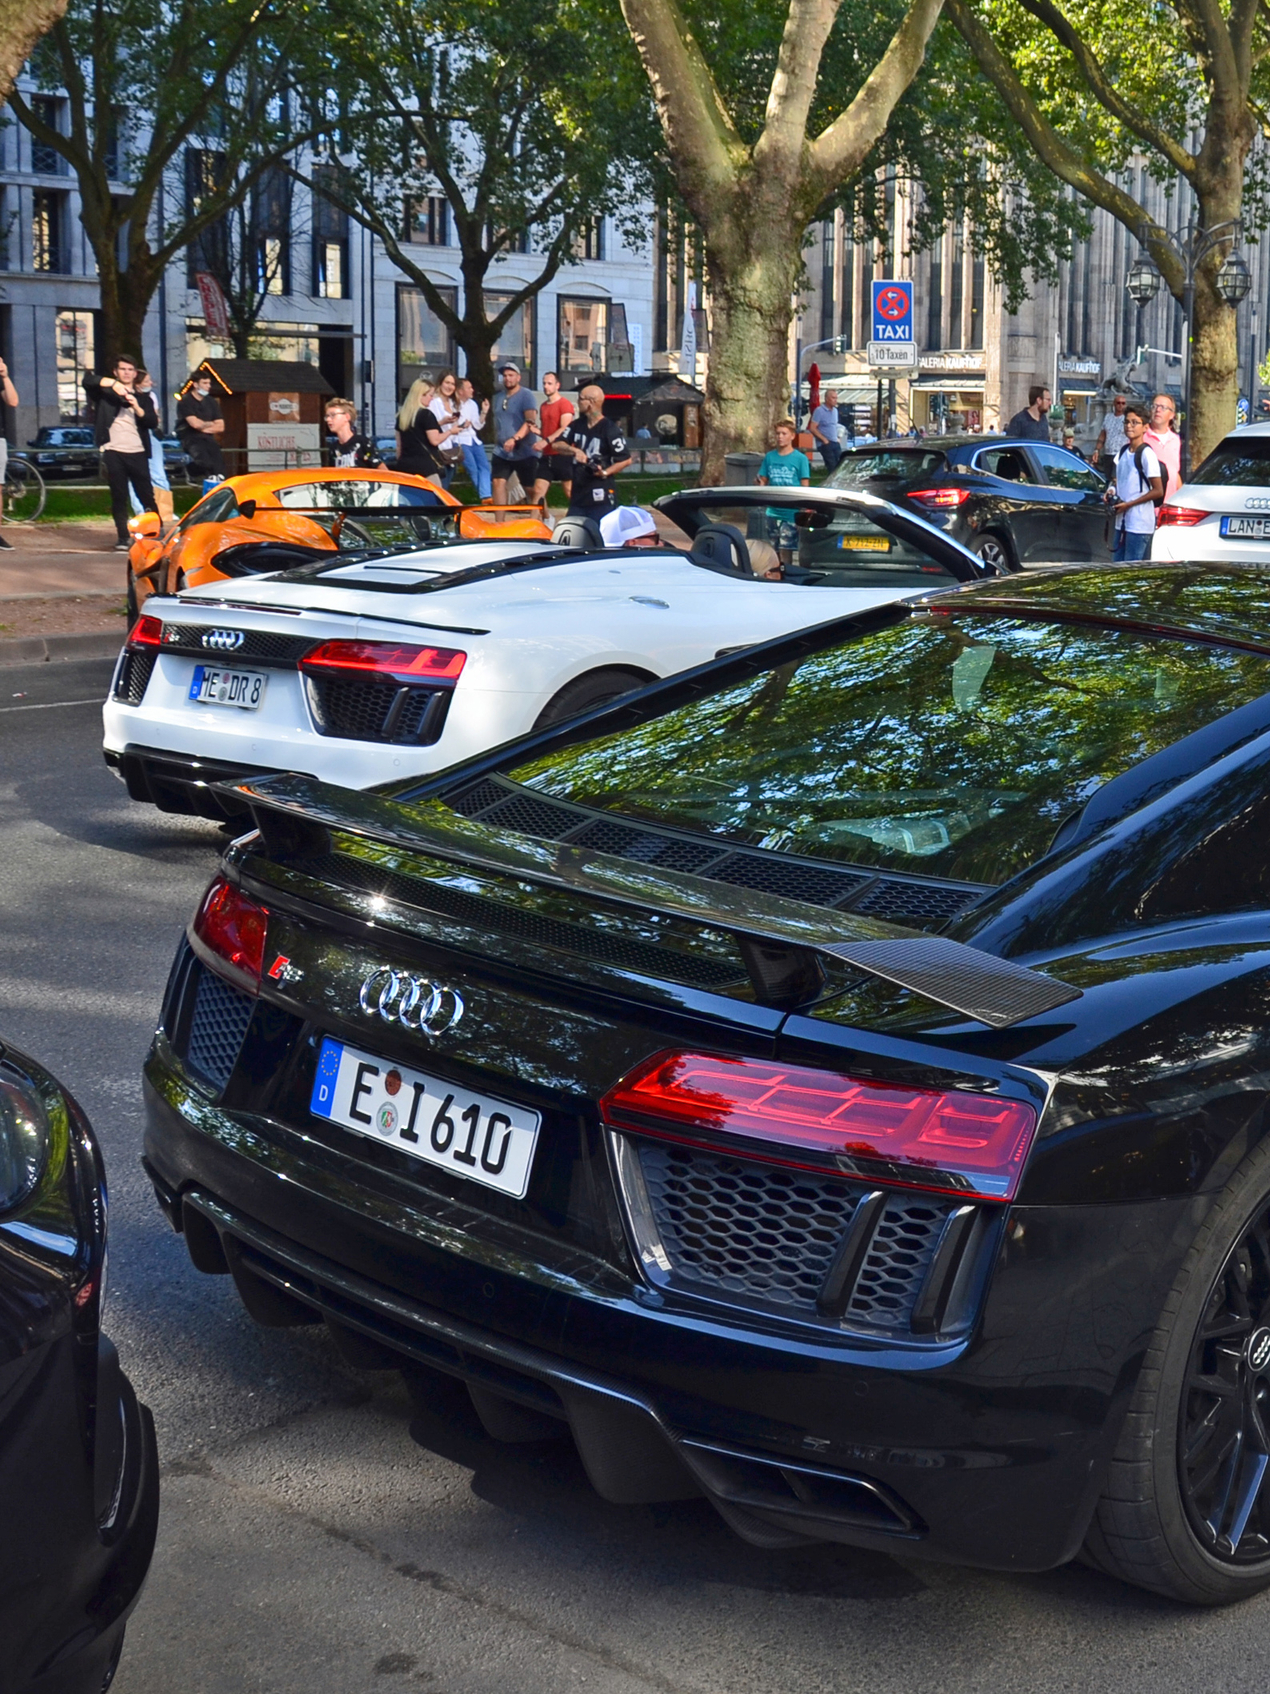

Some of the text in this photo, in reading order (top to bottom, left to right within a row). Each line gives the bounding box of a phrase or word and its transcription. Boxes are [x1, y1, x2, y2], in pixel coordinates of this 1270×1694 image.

[876, 325, 909, 339] TAXI
[876, 348, 908, 359] 10 Taxen
[1229, 519, 1255, 534] LAN
[1263, 520, 1270, 535] E
[200, 671, 261, 704] ME DR 8
[319, 1085, 328, 1102] D
[349, 1062, 380, 1124] E
